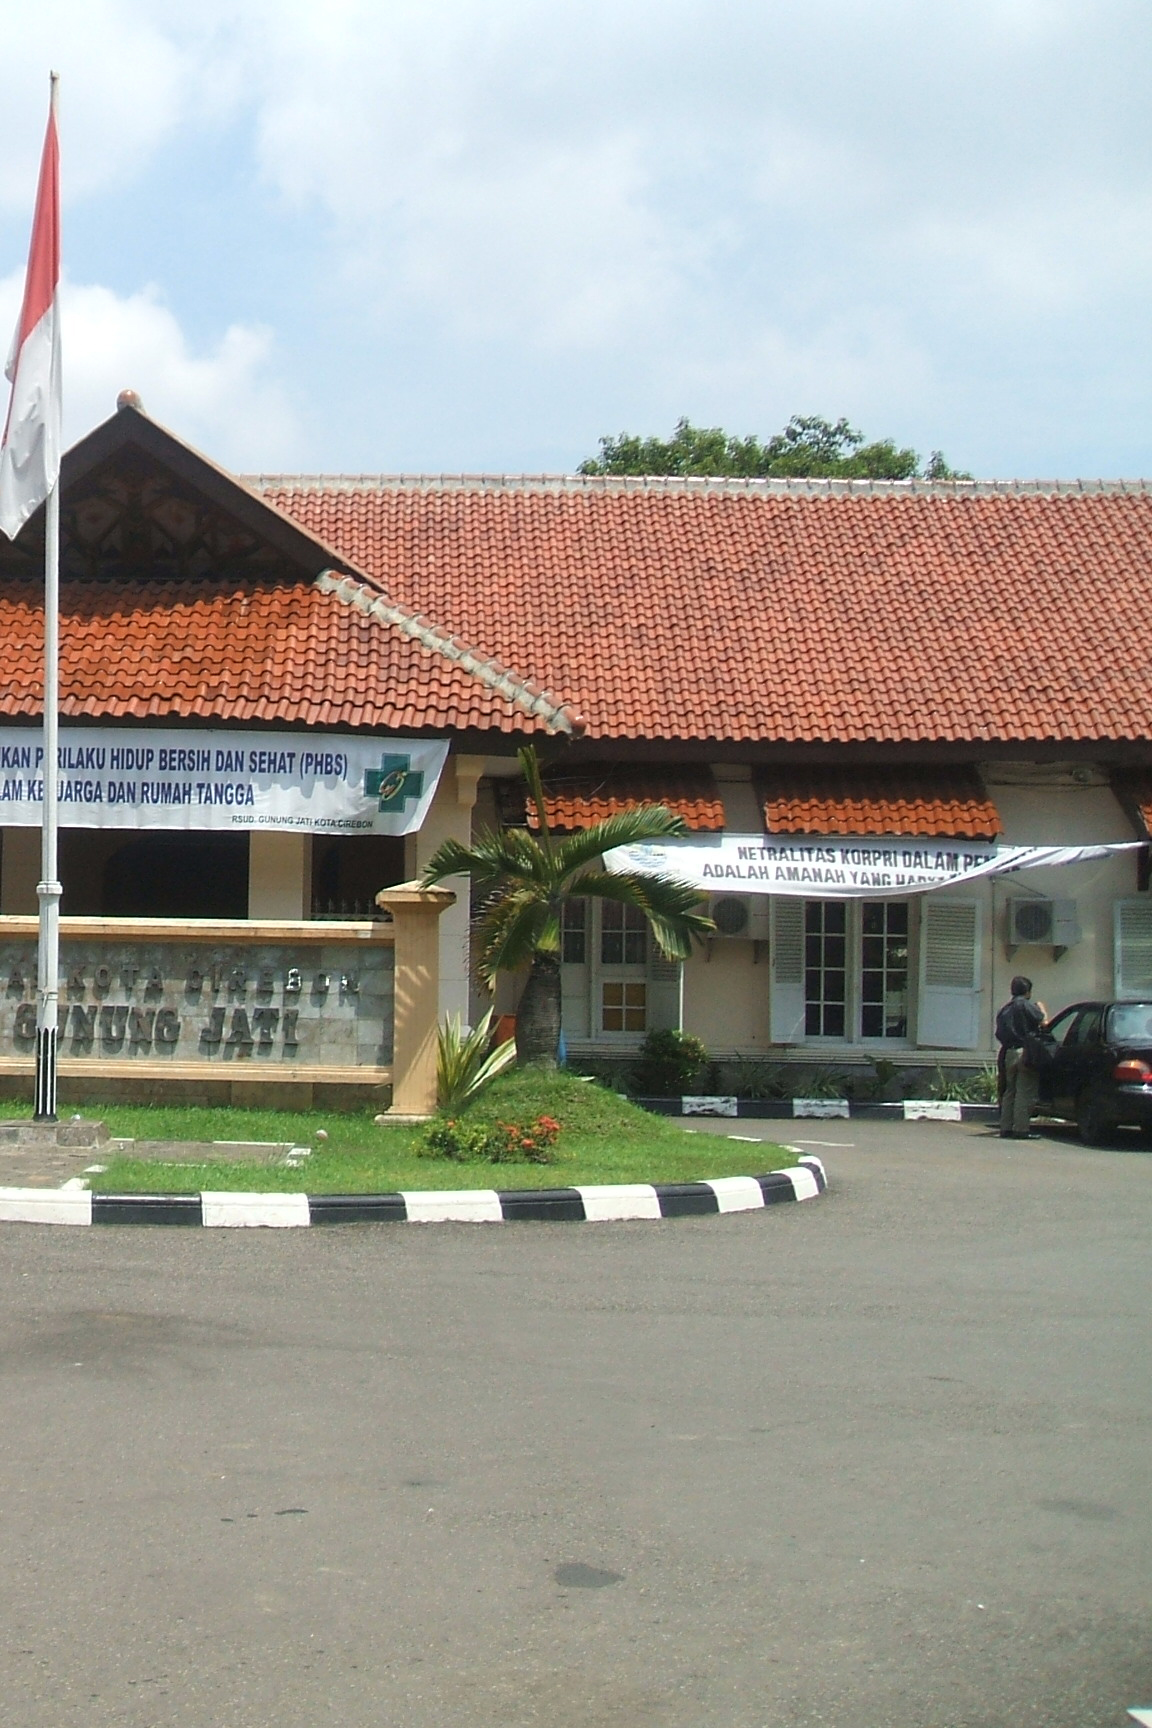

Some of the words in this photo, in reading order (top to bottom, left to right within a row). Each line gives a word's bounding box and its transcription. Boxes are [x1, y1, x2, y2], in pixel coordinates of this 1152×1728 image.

[34, 746, 106, 770] PRILAKU
[110, 748, 154, 771] HIDUP
[158, 748, 211, 772] BERSIH
[215, 750, 244, 773] DAN
[248, 751, 296, 774] SEHAT
[299, 752, 348, 780] (PHBS)
[27, 778, 103, 804] KEUARGA
[107, 781, 136, 804] DAN
[140, 782, 192, 805] RUMAH
[196, 782, 255, 806] TANGGA
[258, 815, 294, 825] GUNUNG
[296, 817, 313, 826] JATI
[314, 818, 336, 828] KOTA
[337, 819, 374, 829] CIREBON
[737, 846, 836, 863] NETRALITAS
[840, 848, 898, 868] KORPRI
[902, 850, 959, 872] DALAM
[702, 863, 770, 880] ADALAH
[775, 866, 846, 884] AMANAH
[849, 870, 892, 887] YANG
[67, 963, 164, 992] KOTA
[200, 1006, 299, 1044] JATI
